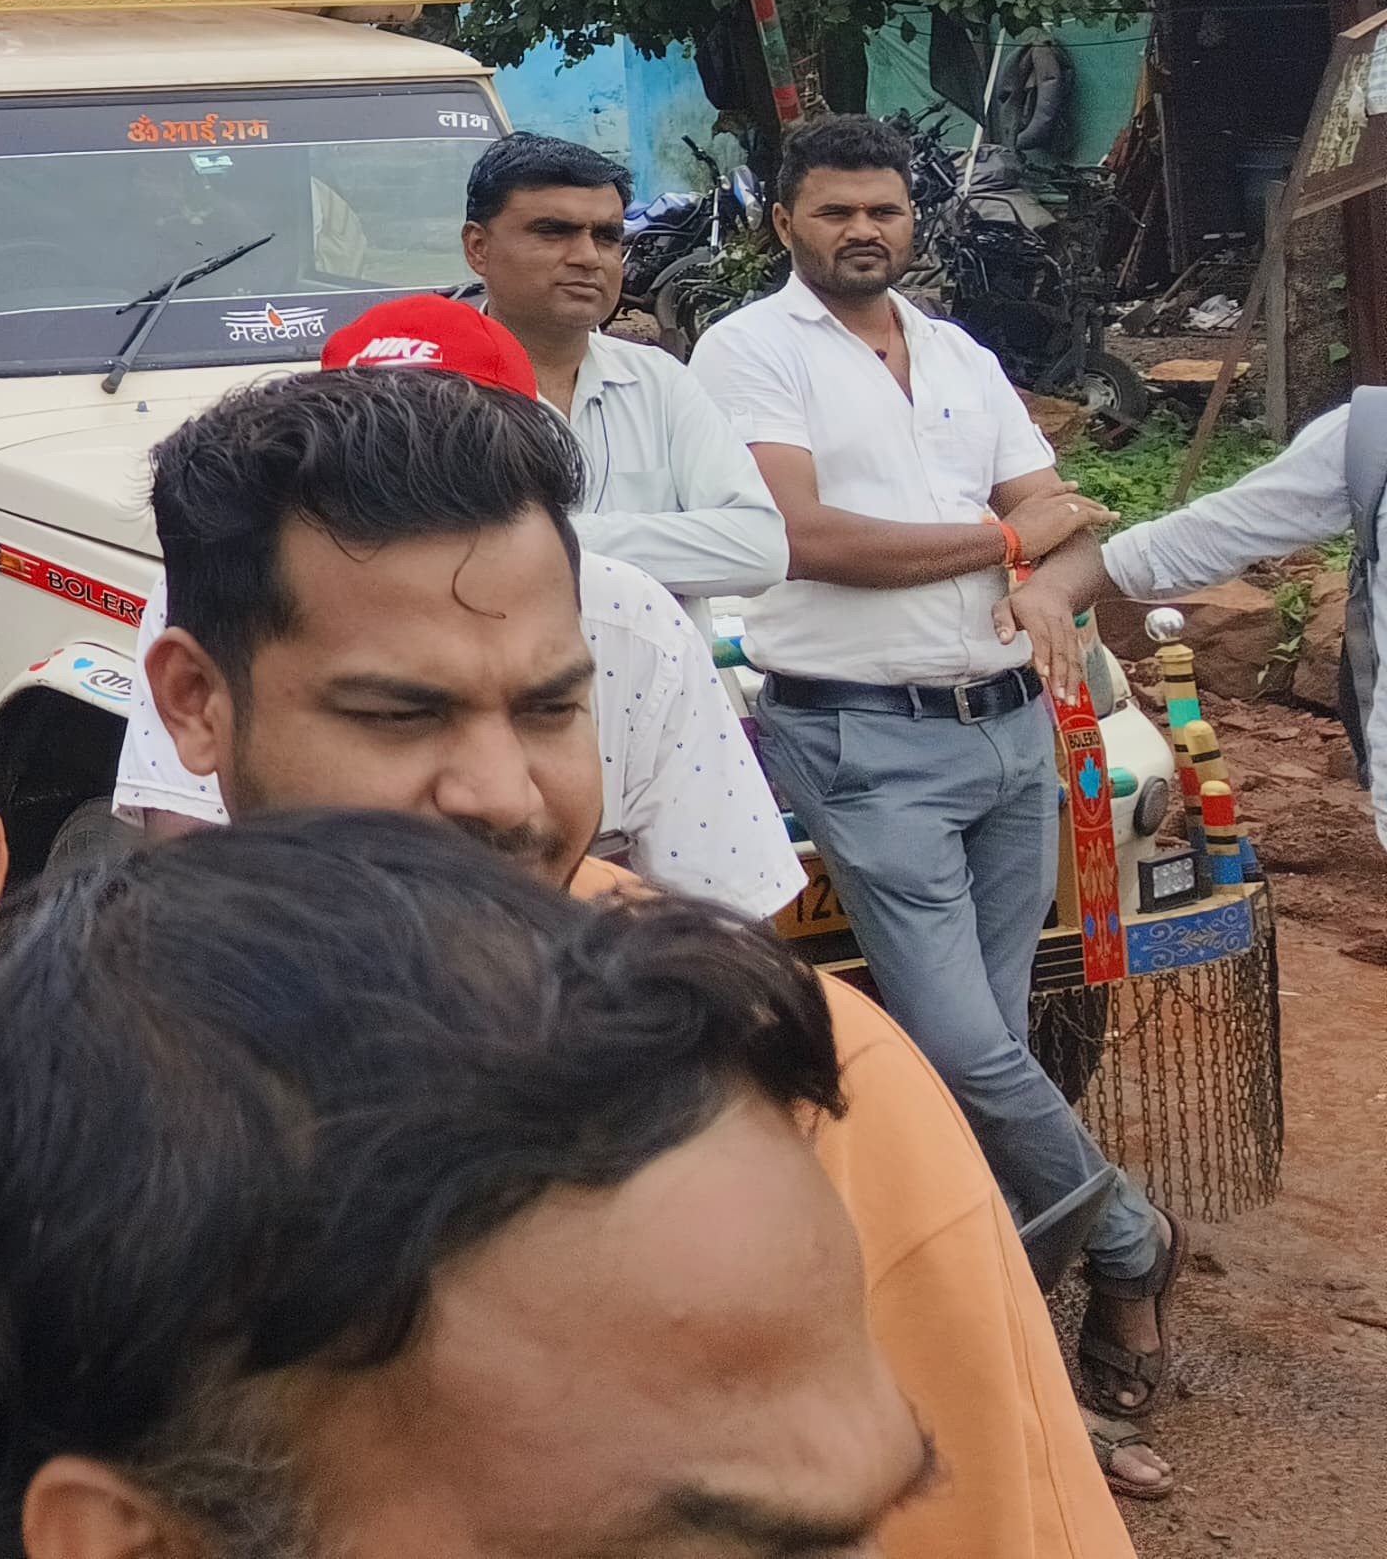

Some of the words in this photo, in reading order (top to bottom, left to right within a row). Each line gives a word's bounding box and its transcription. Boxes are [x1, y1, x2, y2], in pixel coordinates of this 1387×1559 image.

[220, 119, 269, 140] राम
[437, 110, 490, 131] लाभ
[225, 315, 326, 344] महाकाल
[359, 337, 440, 360] NIKE
